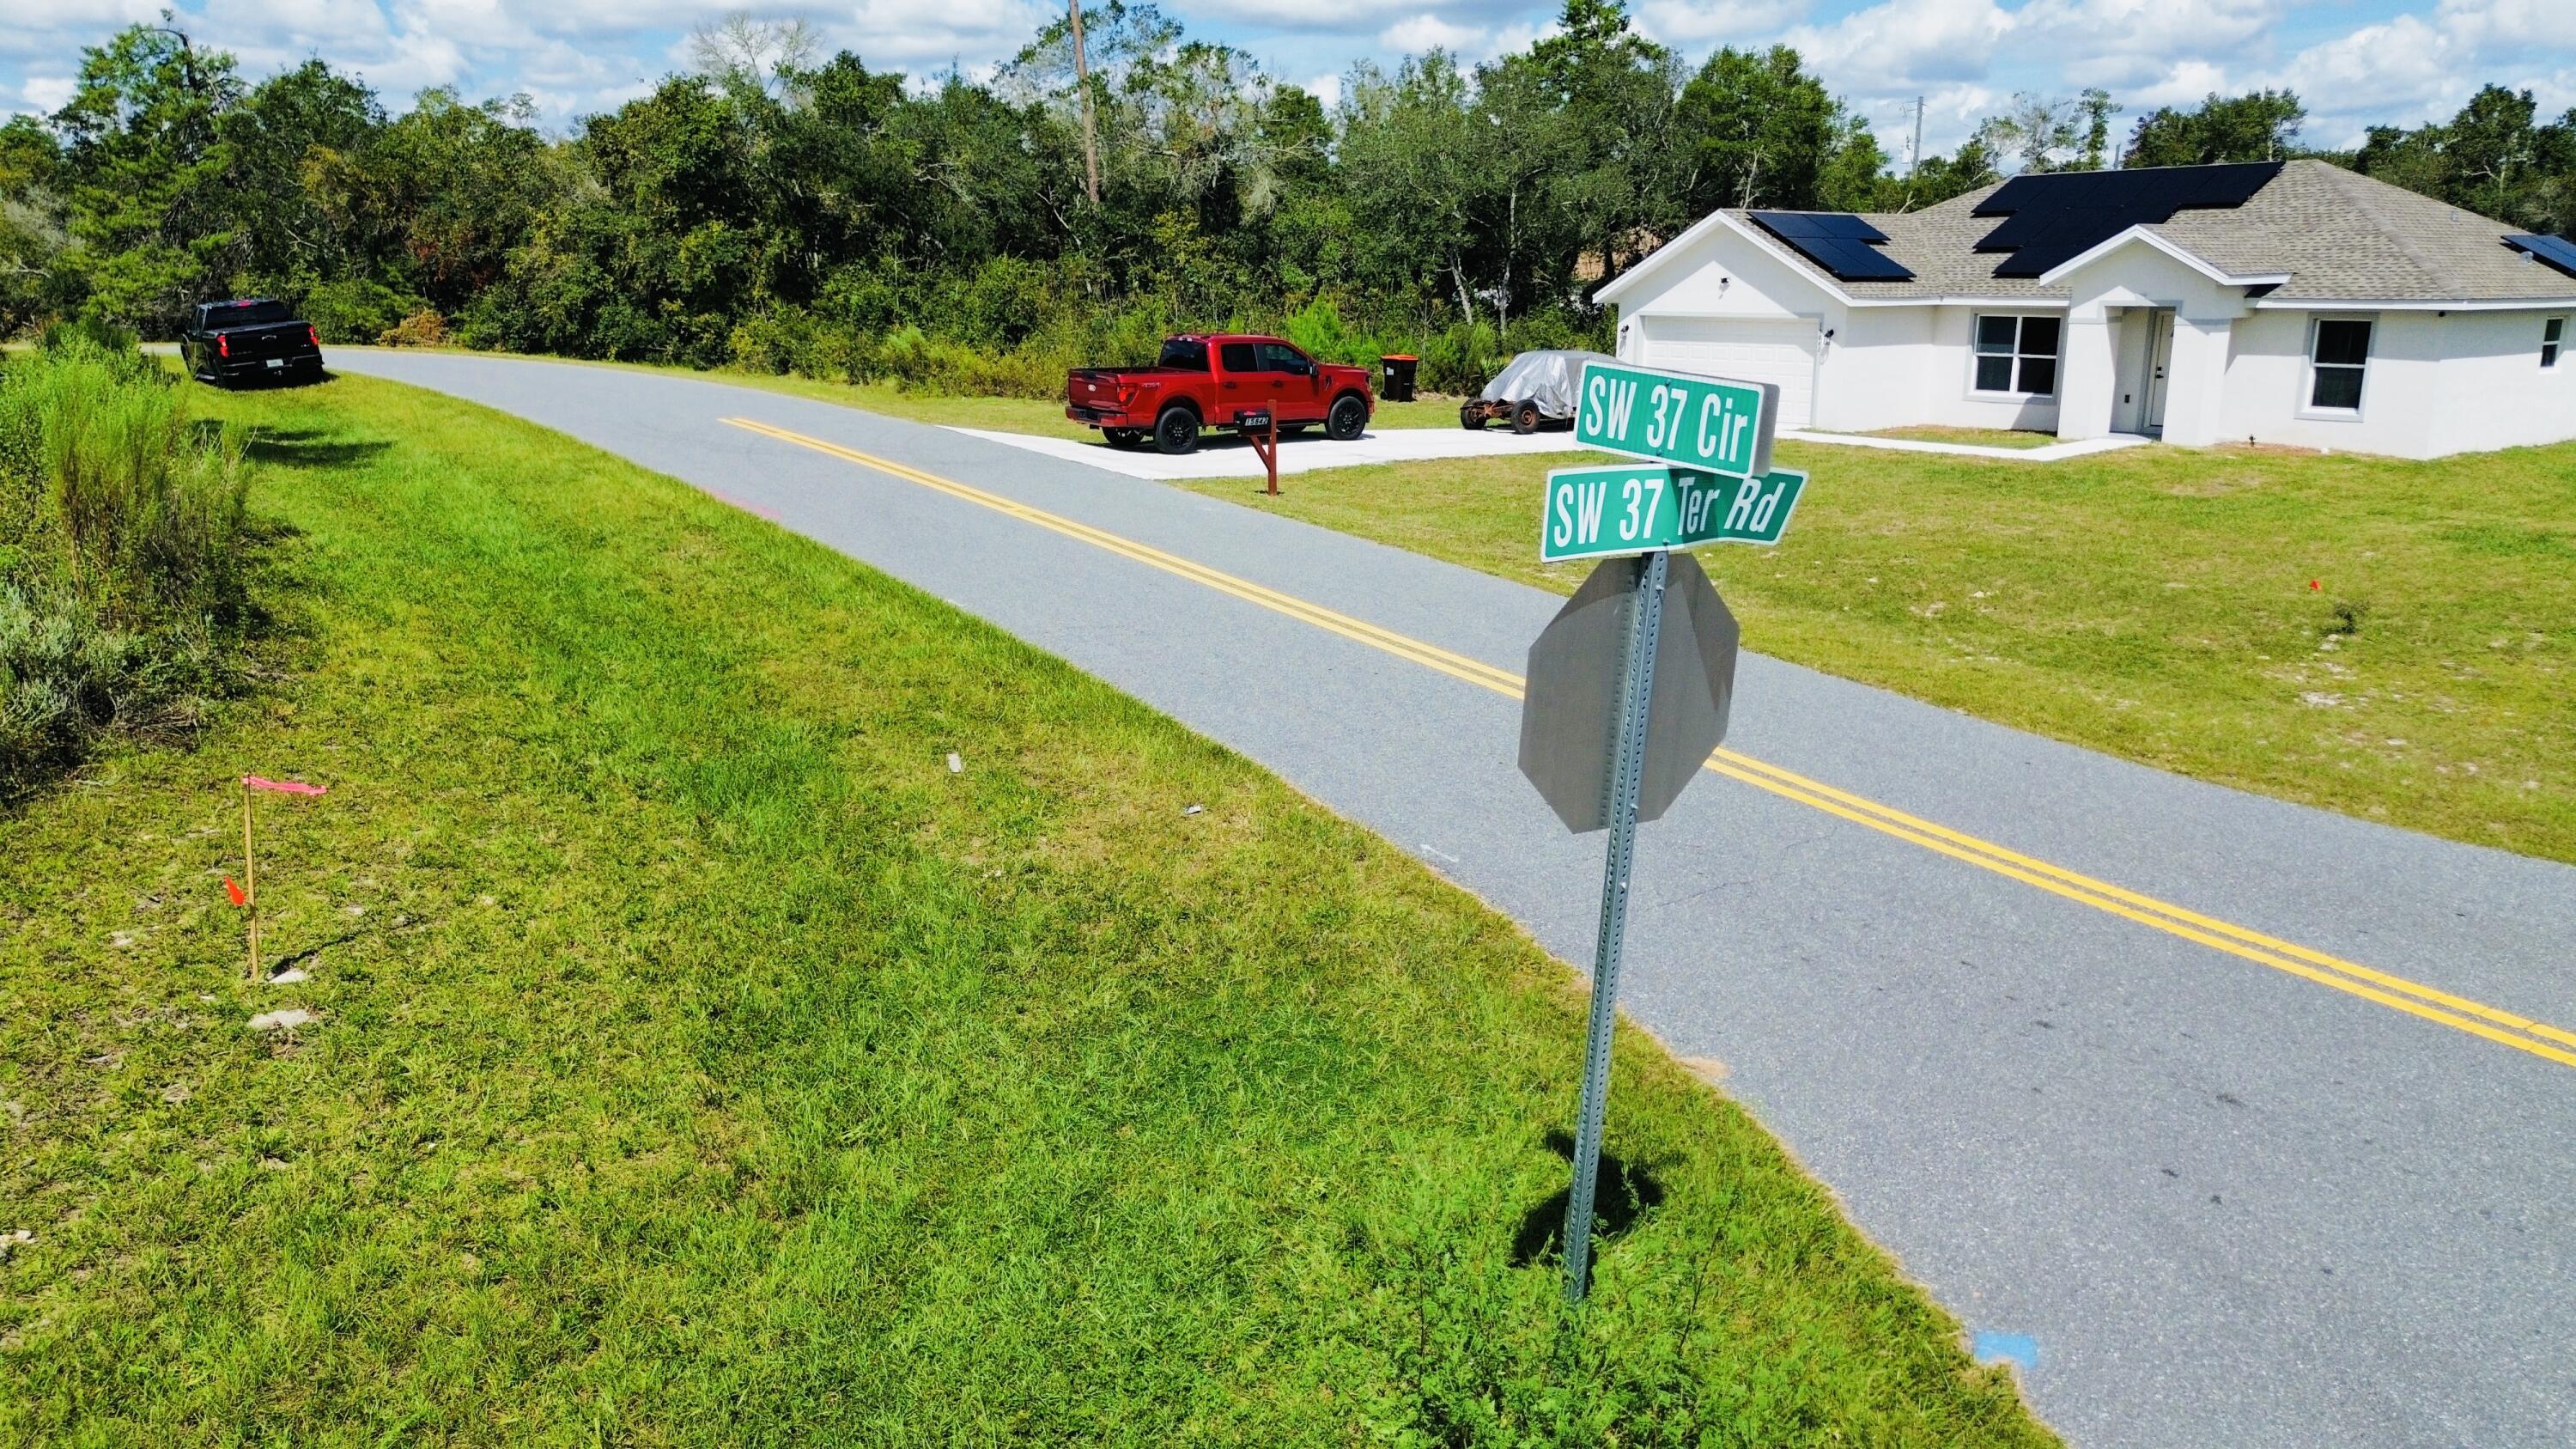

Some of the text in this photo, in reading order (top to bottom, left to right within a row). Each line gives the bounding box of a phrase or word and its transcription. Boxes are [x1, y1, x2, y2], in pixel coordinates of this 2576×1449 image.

[1585, 375, 1748, 463] SW 37 Cir
[1553, 477, 1786, 547] SW 37 Ter Rd
